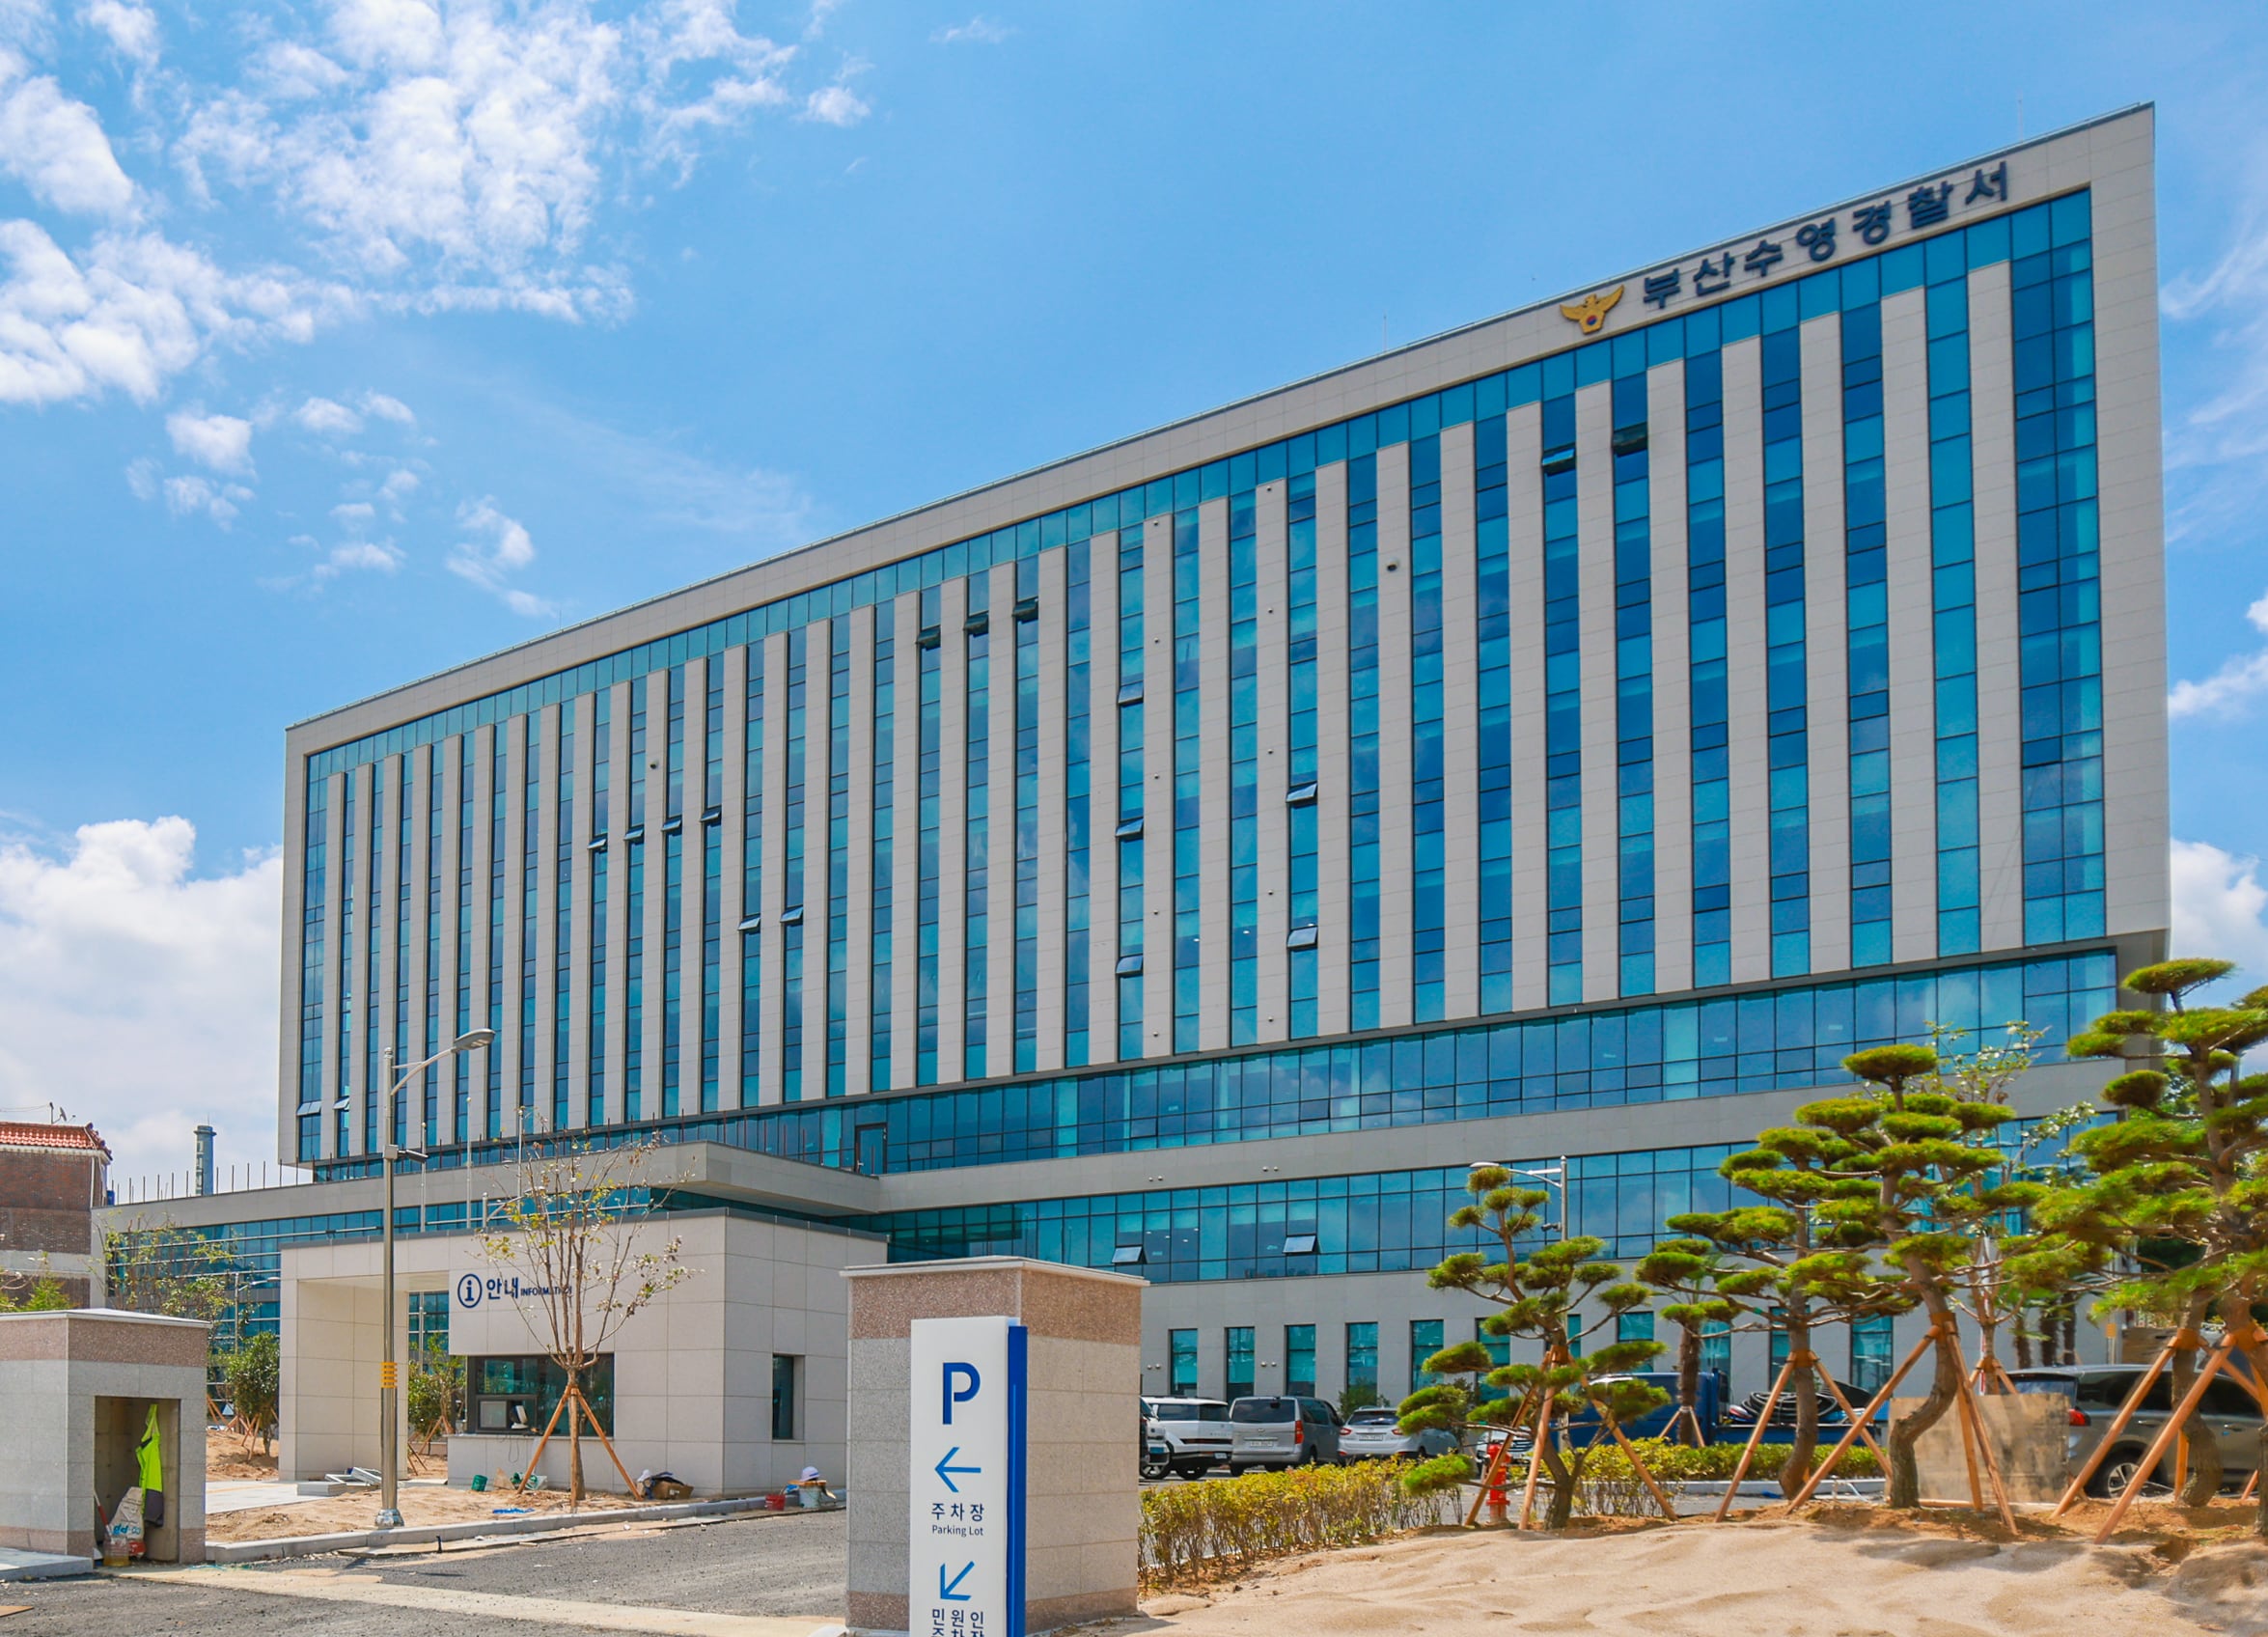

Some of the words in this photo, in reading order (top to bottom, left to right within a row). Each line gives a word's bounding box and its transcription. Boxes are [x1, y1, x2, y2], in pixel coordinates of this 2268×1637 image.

[1643, 161, 2008, 309] 부산수영경찰서
[486, 1277, 518, 1299] 안내
[520, 1286, 572, 1295] INFORMTIN
[942, 1362, 982, 1425] P
[931, 1502, 984, 1522] 주차장
[932, 1524, 966, 1538] Parking
[969, 1526, 983, 1536] Lot
[931, 1607, 983, 1629] 민원인
